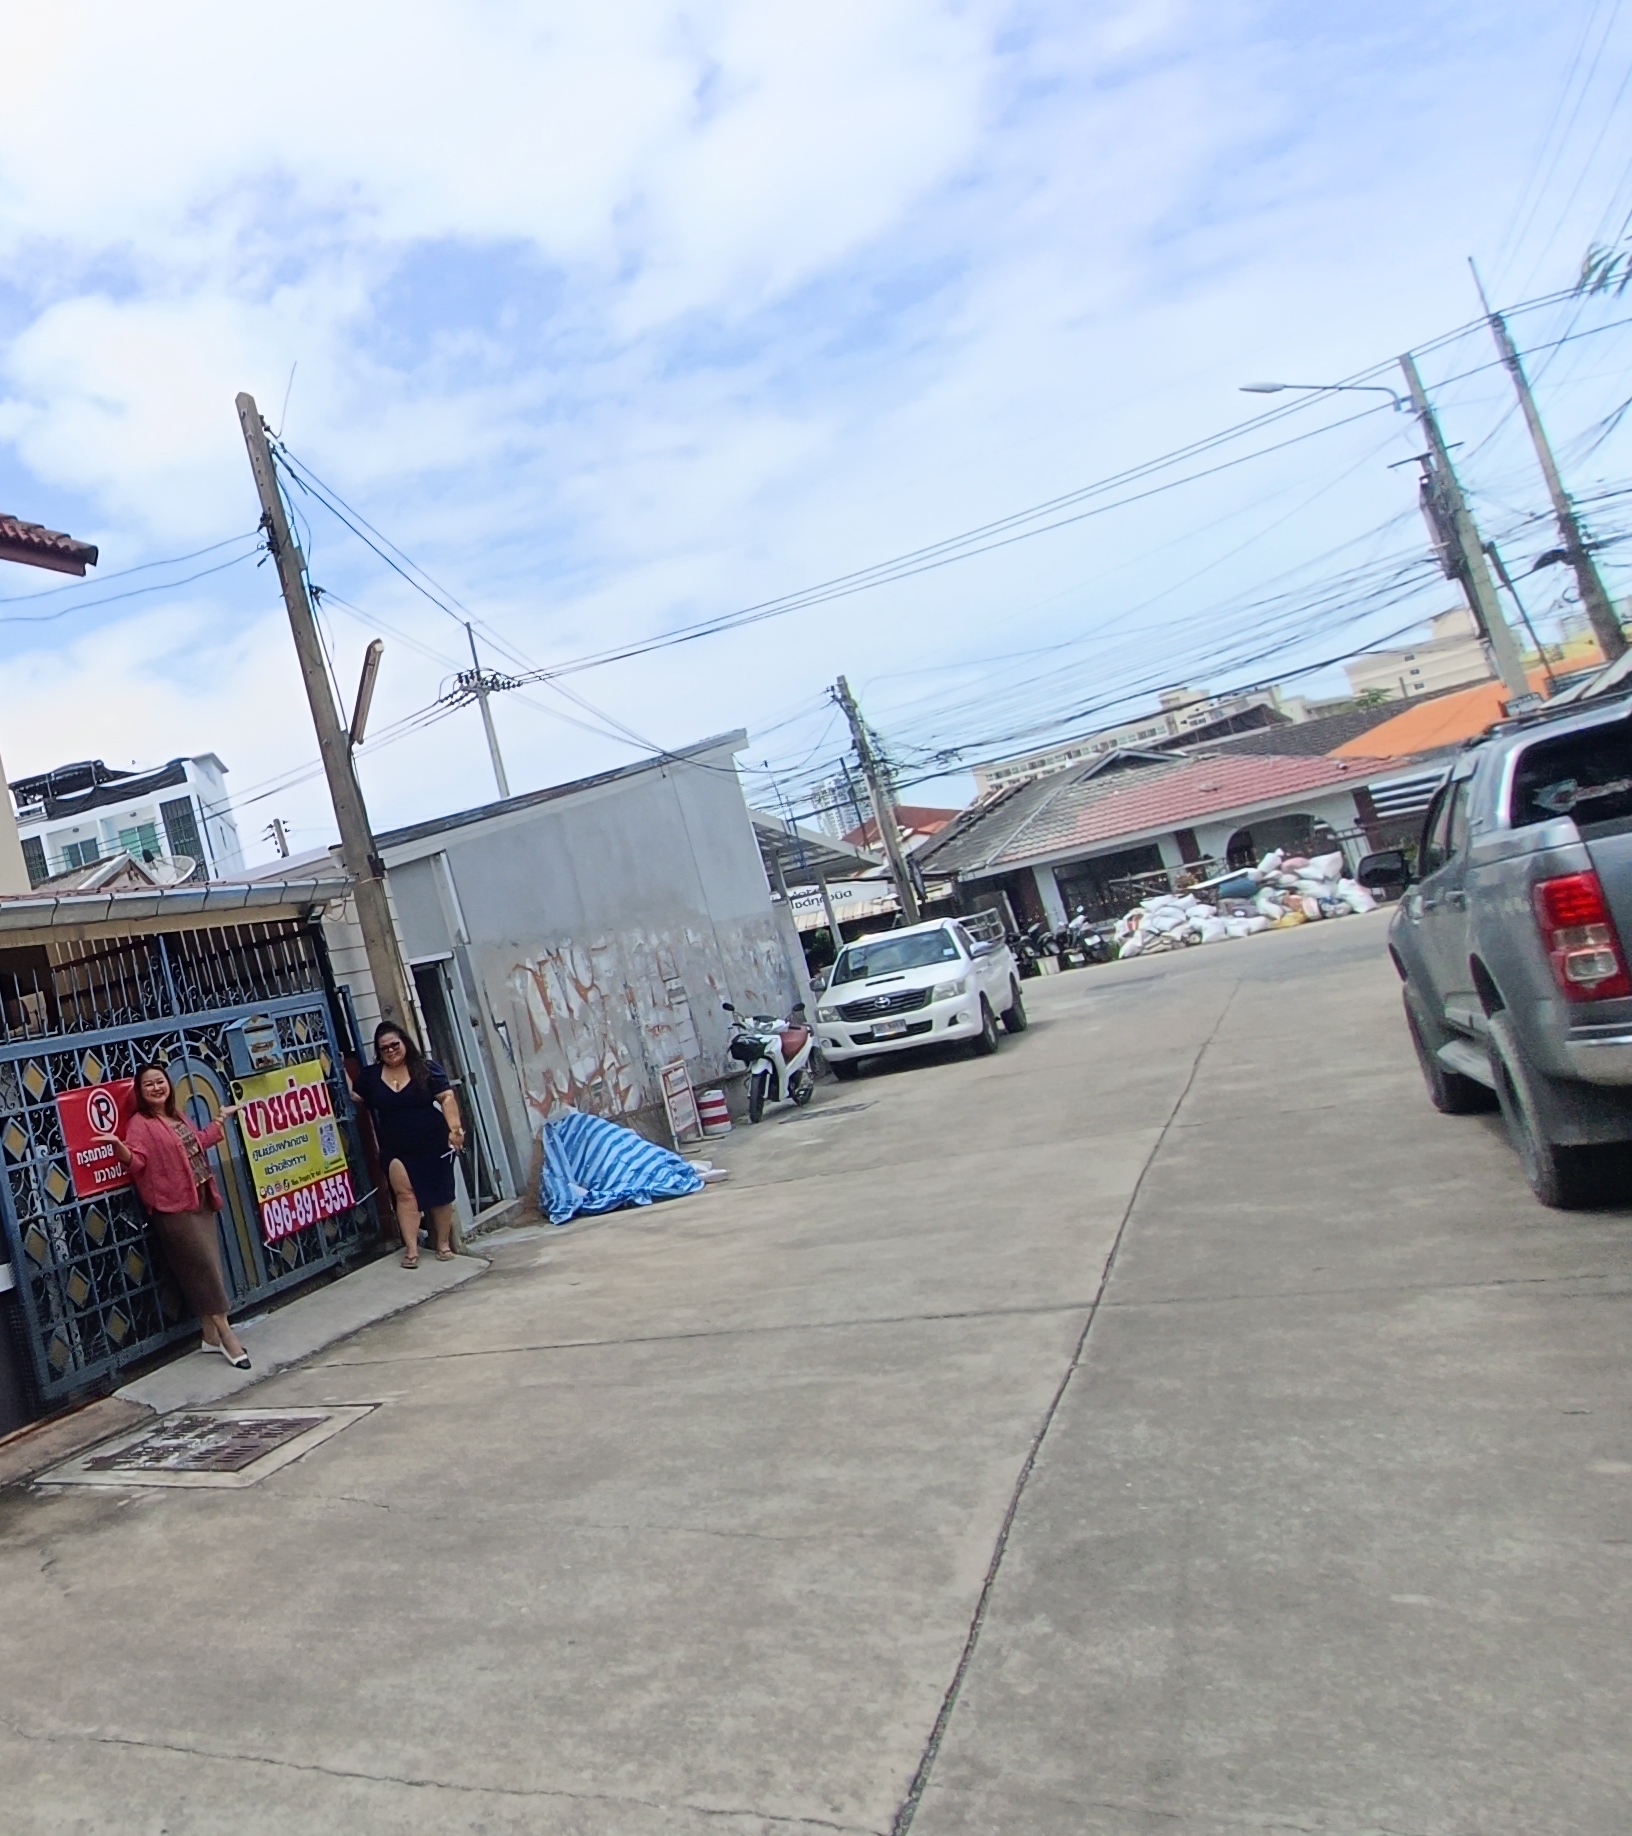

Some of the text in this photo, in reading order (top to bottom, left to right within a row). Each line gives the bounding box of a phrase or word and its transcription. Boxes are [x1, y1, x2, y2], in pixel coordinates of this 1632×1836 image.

[243, 1078, 331, 1139] ขายด่วน
[76, 1143, 114, 1168] กรุณาอย
[93, 1161, 124, 1184] ขวางป
[262, 1172, 355, 1239] 096-891-5551
